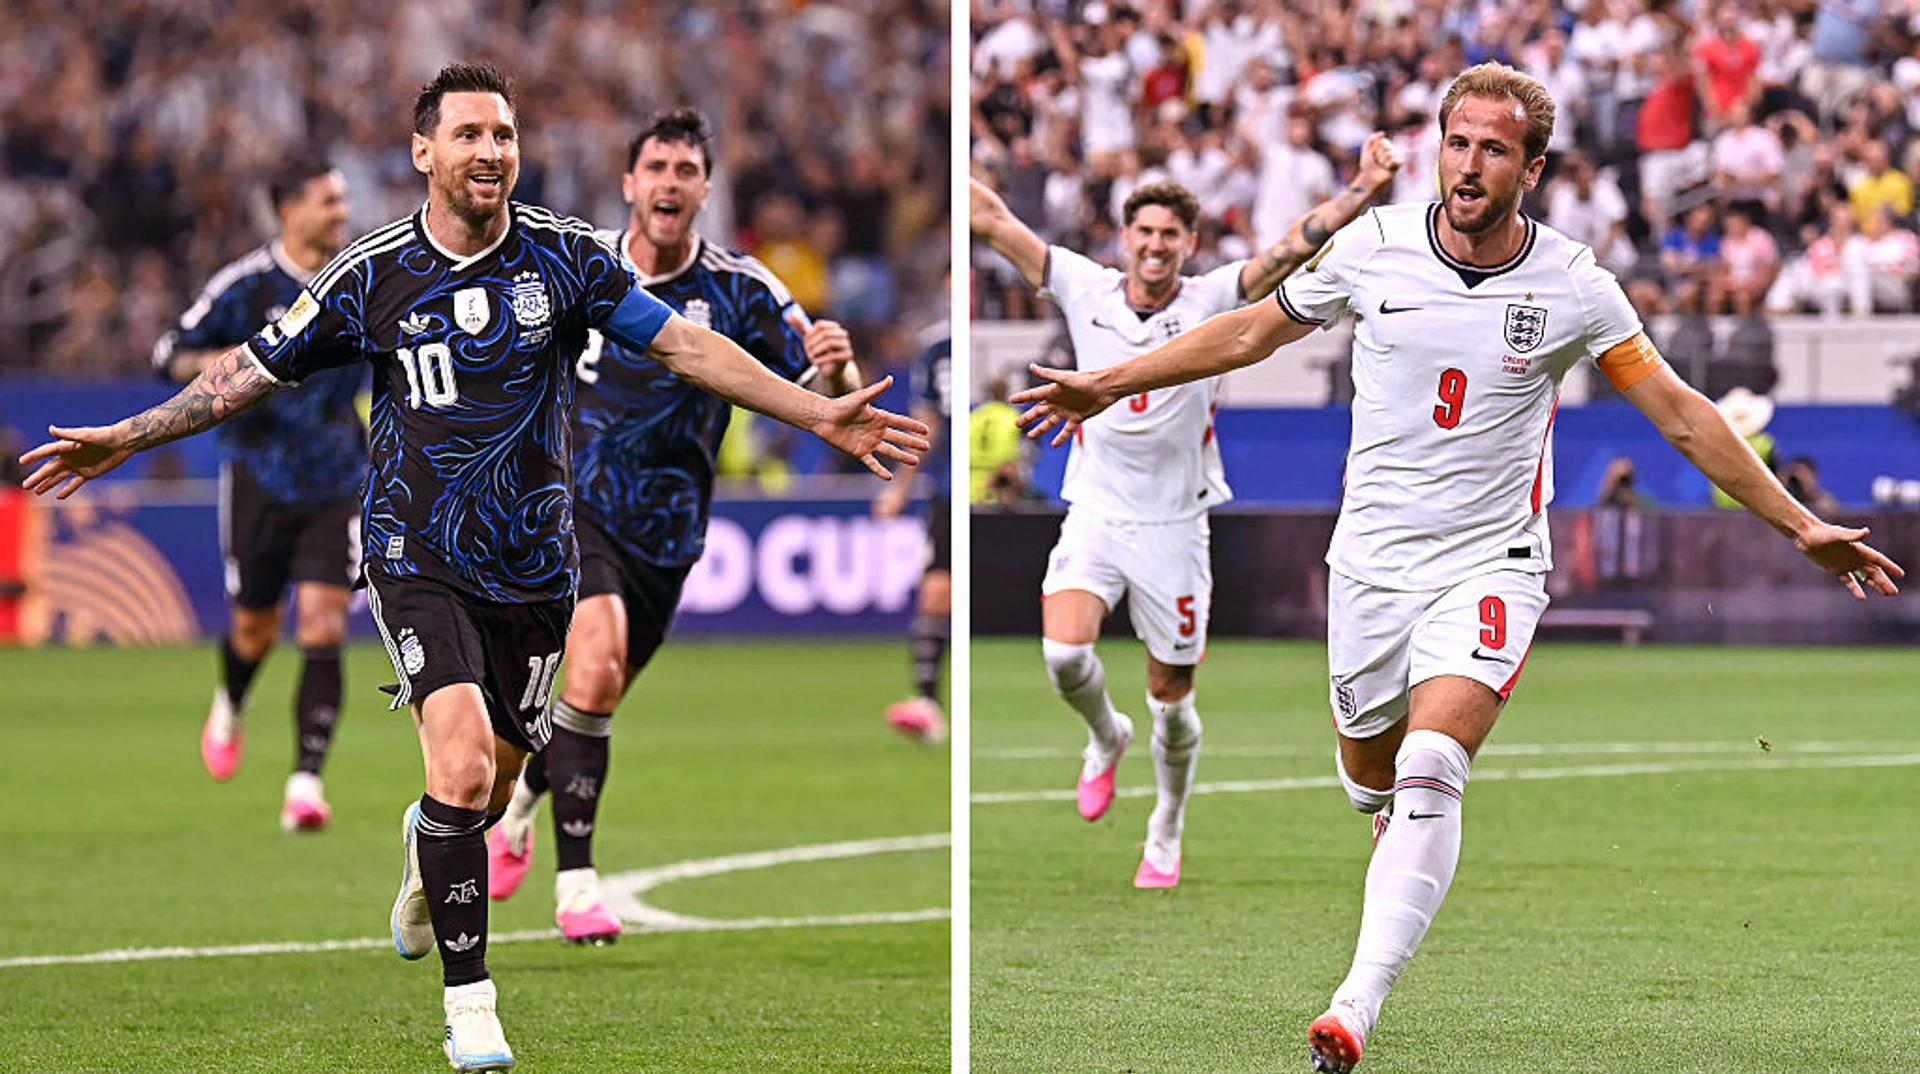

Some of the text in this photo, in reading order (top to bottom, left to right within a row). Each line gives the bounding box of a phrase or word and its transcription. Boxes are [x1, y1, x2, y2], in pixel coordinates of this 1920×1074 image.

[396, 342, 459, 410] 10
[1433, 367, 1468, 430] 9
[756, 514, 931, 615] CUP
[1177, 595, 1197, 637] 5
[1478, 595, 1507, 651] 9
